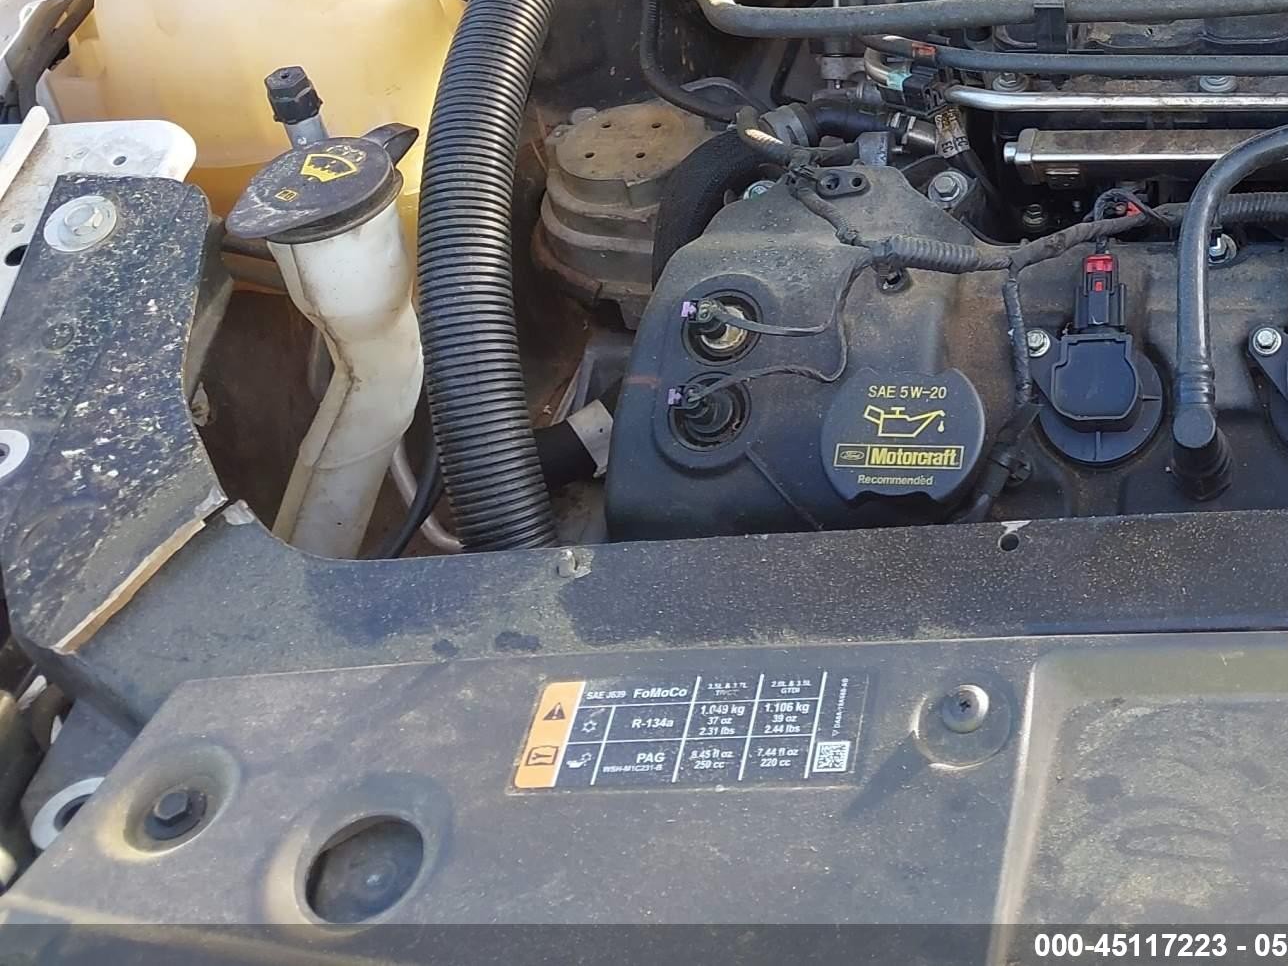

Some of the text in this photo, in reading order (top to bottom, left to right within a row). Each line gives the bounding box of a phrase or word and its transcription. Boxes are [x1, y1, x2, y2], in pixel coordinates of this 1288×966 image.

[867, 386, 948, 399] SAE 5W-20
[870, 447, 957, 466] Motorcraft
[857, 474, 934, 486] Recommended
[586, 690, 605, 700] SAE
[633, 686, 688, 699] FoMoCo
[730, 704, 745, 716] kg
[795, 702, 810, 714] kg
[631, 718, 674, 729] R-134a
[706, 717, 718, 725] 37
[772, 715, 784, 723] 39
[698, 727, 735, 736] 2.31 lbs
[764, 724, 801, 734] 2.44 lbs
[721, 750, 733, 758] oz
[787, 748, 799, 756] oz
[636, 751, 666, 764] PAG
[760, 758, 778, 767] 220
[693, 761, 725, 770] 250 cc
